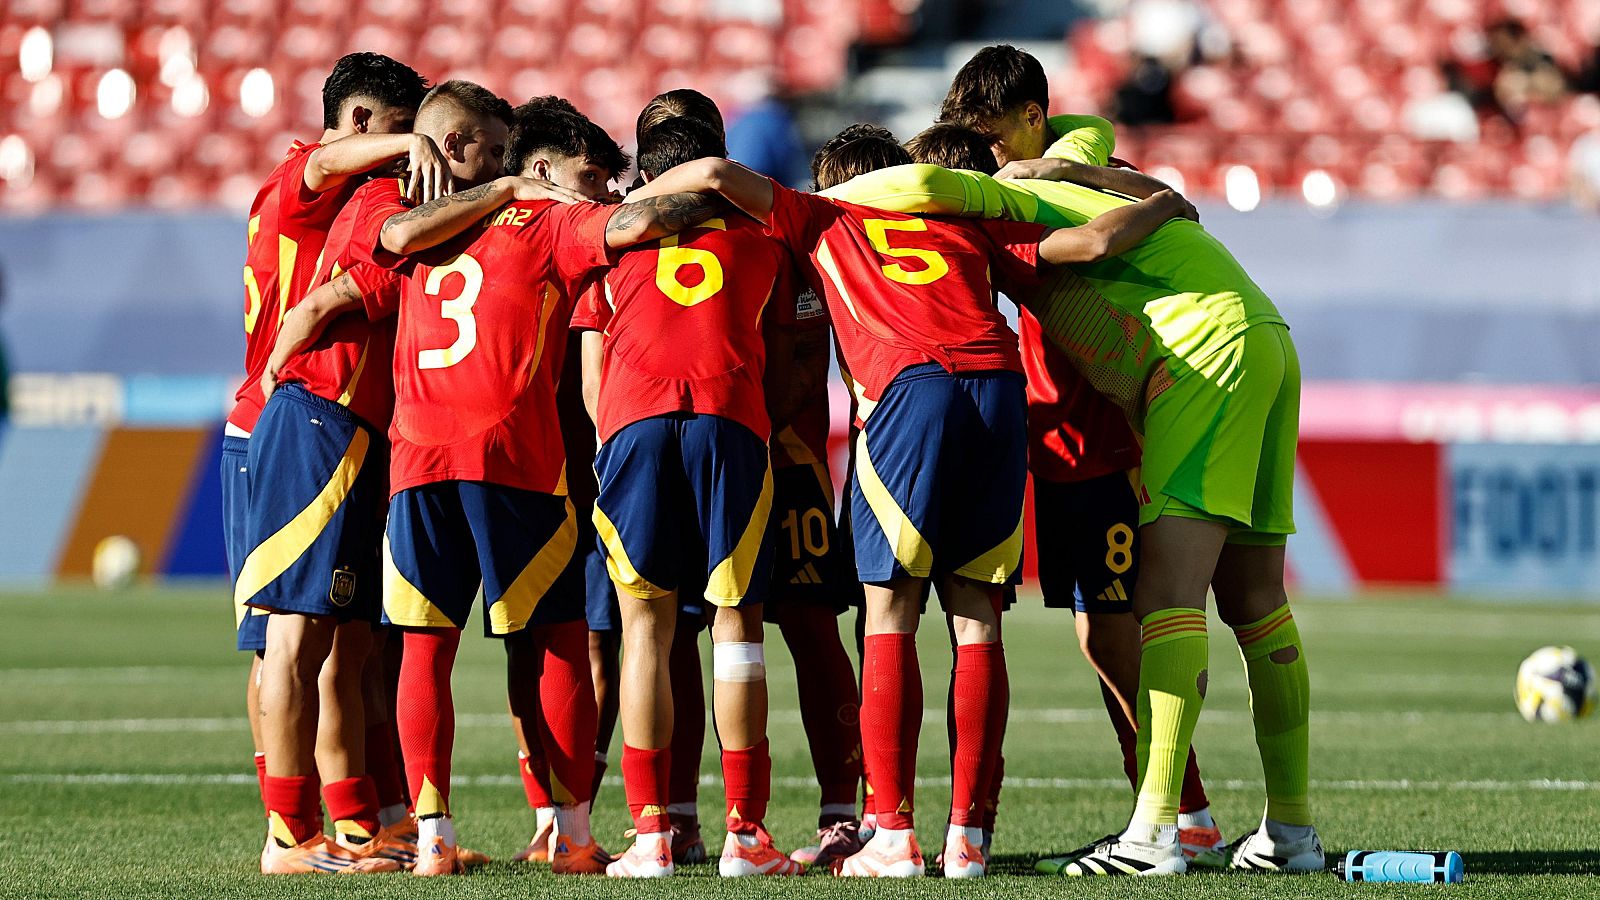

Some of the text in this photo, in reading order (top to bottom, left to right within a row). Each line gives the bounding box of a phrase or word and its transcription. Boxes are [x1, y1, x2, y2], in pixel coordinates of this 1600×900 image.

[655, 218, 727, 307] 6
[862, 217, 949, 285] 5
[418, 253, 484, 369] 3
[781, 507, 829, 559] 10
[1105, 522, 1134, 574] 8
